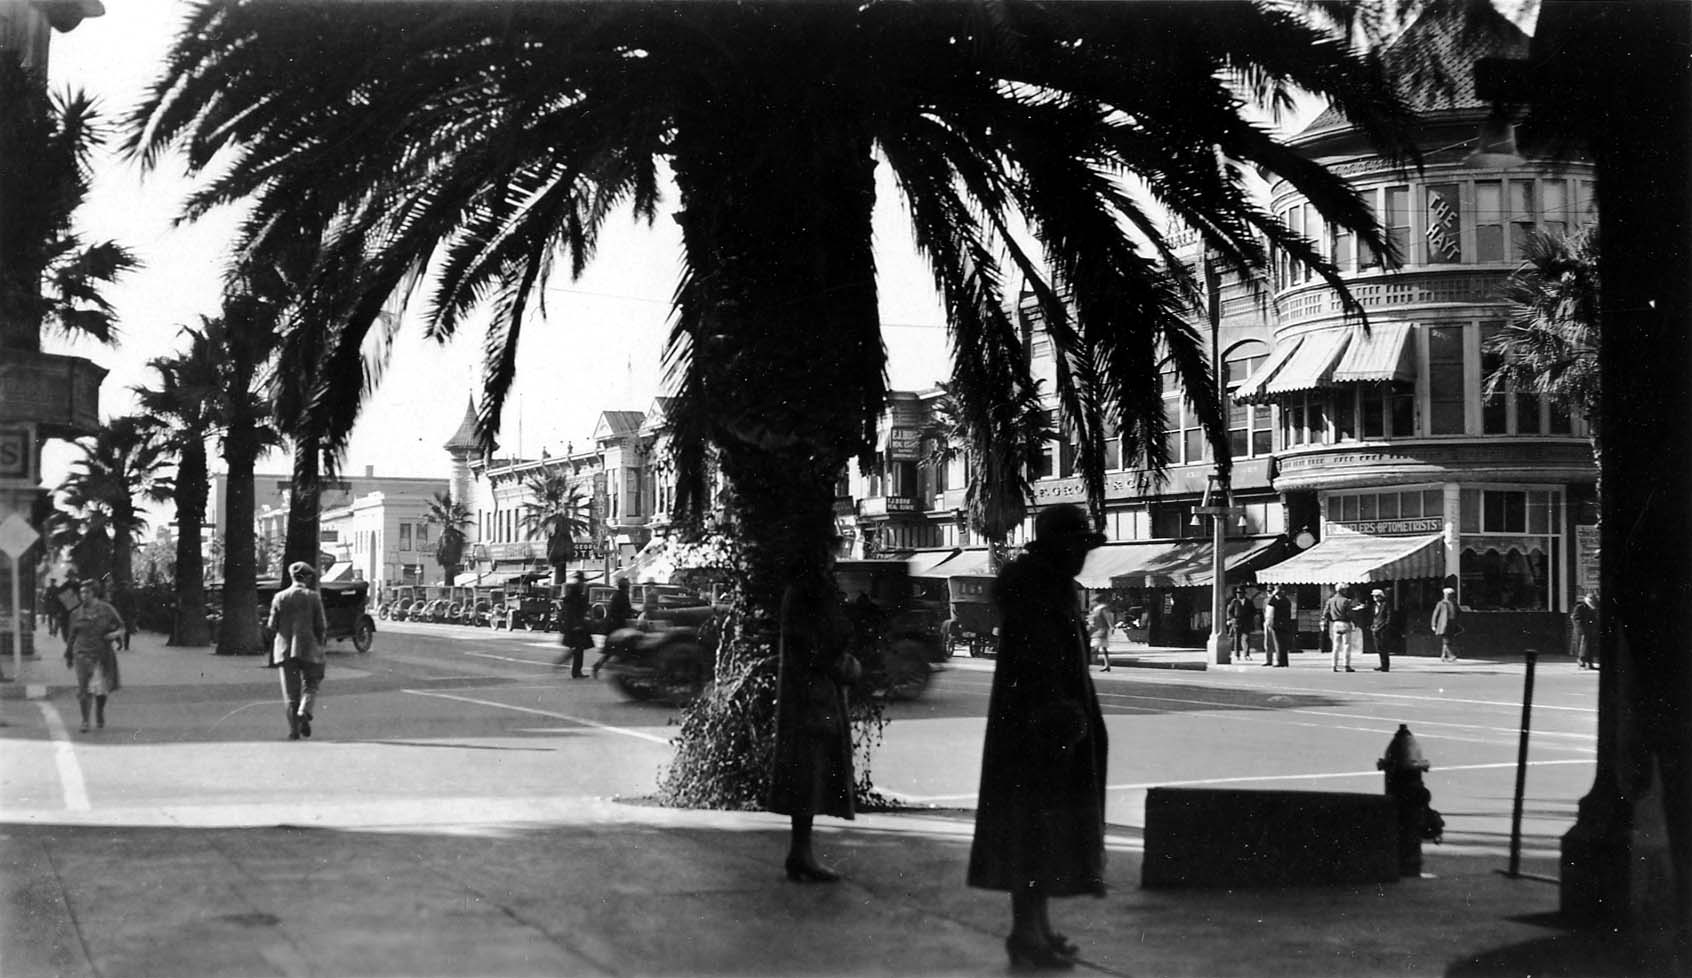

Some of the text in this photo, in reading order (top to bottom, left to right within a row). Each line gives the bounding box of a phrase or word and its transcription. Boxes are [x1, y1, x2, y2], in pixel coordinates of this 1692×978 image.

[1429, 190, 1458, 227] THE
[1426, 223, 1460, 260] HAYT
[1377, 519, 1438, 533] OPTOMETRISTS
